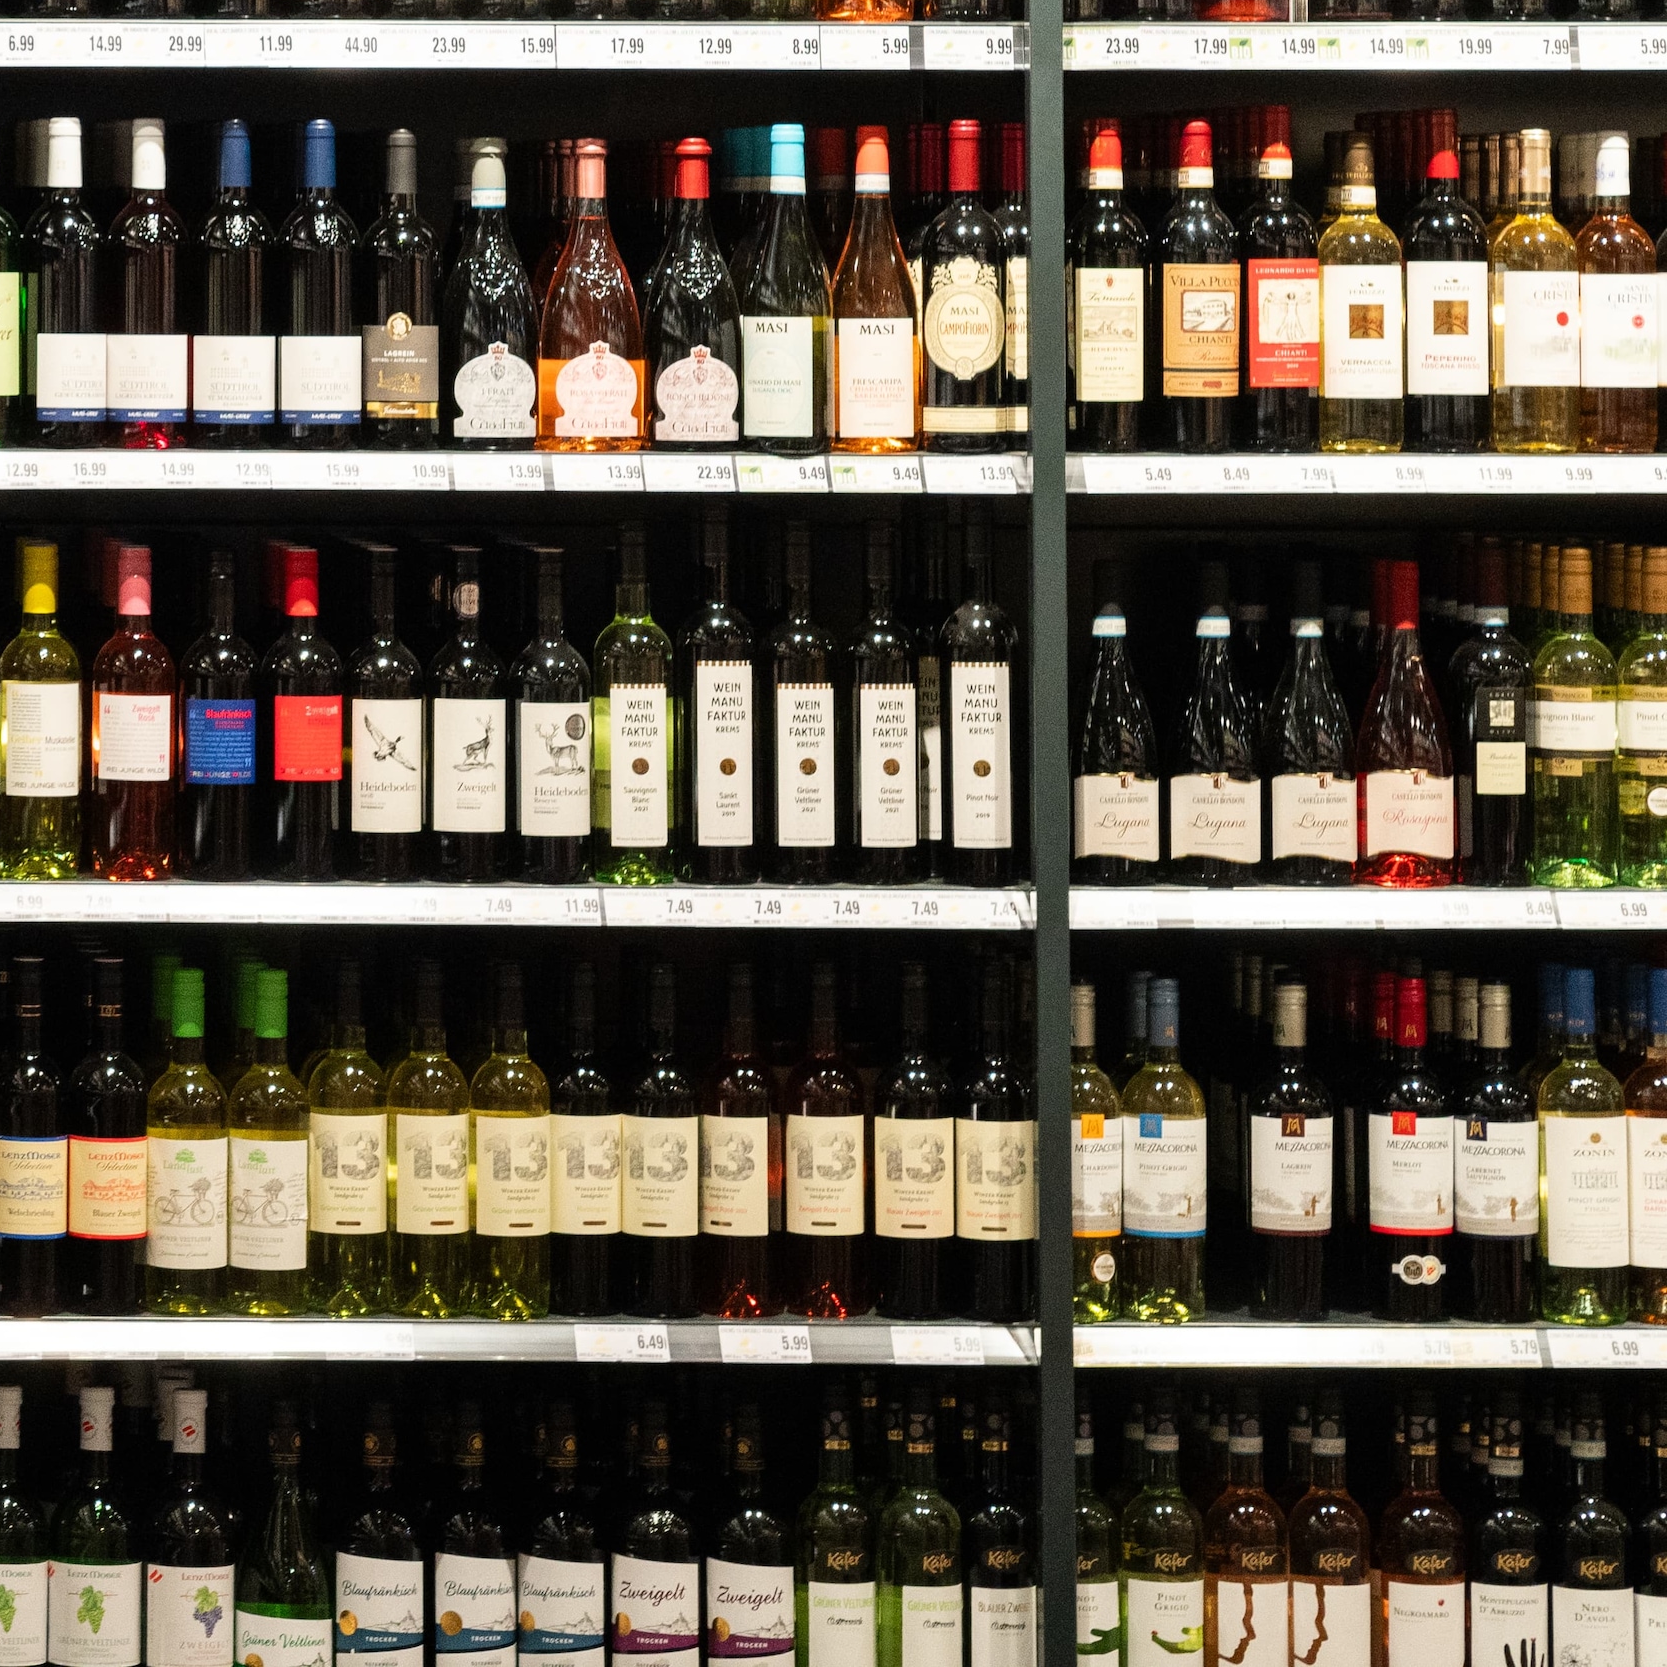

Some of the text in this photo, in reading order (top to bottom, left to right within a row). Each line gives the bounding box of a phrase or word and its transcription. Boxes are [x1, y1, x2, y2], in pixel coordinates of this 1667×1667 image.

[9, 36, 34, 51] 6.99
[89, 36, 122, 51] 14.99
[169, 36, 202, 51] 29.99
[259, 36, 292, 52] 11.99
[345, 37, 377, 53] 44.90
[433, 38, 465, 53] 23.99
[521, 38, 554, 53] 15.99
[611, 39, 644, 53] 17.99
[699, 39, 732, 54] 12.99
[793, 39, 818, 54] 8.99
[883, 39, 908, 54] 5.99
[986, 39, 1012, 54] 9.99
[1282, 39, 1315, 54] 14.99
[1459, 40, 1492, 54] 19.99
[1543, 40, 1569, 54] 7.99
[1171, 276, 1206, 287] VILLA
[950, 306, 979, 316] MASI
[755, 322, 788, 333] MASI
[860, 324, 895, 335] MASI
[1189, 336, 1232, 344] CHIANTI
[1425, 354, 1476, 362] PEPERINO
[74, 463, 106, 476] 16.99
[413, 465, 445, 478] 10.99
[509, 465, 542, 478] 13.99
[698, 466, 730, 480] 22.99
[799, 467, 825, 481] 9.49
[1145, 468, 1171, 481] 5.49
[1223, 468, 1249, 480] 8.49
[1301, 468, 1327, 480] 7.99
[1566, 468, 1593, 480] 9.99
[714, 683, 741, 693] WEIN
[132, 704, 160, 713] Zweigelt
[711, 697, 743, 706] MANU
[794, 701, 820, 710] WEIN
[707, 711, 746, 721] FAKTUR
[793, 714, 823, 723] MANU
[789, 728, 825, 737] FAKTUR
[360, 783, 417, 792] Heideboden
[457, 783, 496, 793] Zweigelt
[719, 792, 738, 800] Sankt
[795, 796, 821, 804] Veltliner
[1095, 812, 1149, 838] Lugana
[1189, 812, 1246, 838] Lugana
[486, 899, 512, 912] 7.49
[667, 900, 693, 914] 7.49
[755, 901, 781, 914] 7.49
[1135, 1143, 1197, 1152] MEZZACORONA
[1462, 1145, 1525, 1156] MEZZACORONA
[314, 1132, 379, 1179] 13
[793, 1133, 857, 1181] 13
[879, 1133, 945, 1182] 13
[1466, 1166, 1501, 1174] CABERNET
[1467, 1173, 1506, 1181] SAUVIGNON
[637, 1334, 664, 1350] 6.49
[782, 1336, 808, 1350] 5.99
[1511, 1340, 1538, 1354] 5.79
[827, 1553, 864, 1570] Käfer
[923, 1555, 953, 1574] Käfer
[988, 1550, 1025, 1569] Käfer
[1155, 1553, 1191, 1571] Käfer
[1241, 1552, 1277, 1570] Käfer
[1319, 1553, 1357, 1571] Käfer
[342, 1580, 416, 1597] Blaufränkisch
[523, 1580, 595, 1598] Blaufränkisch
[620, 1580, 686, 1607] Zweigelt
[717, 1586, 783, 1611] Zweigelt
[1157, 1593, 1186, 1602] PINOT
[1479, 1595, 1539, 1604] MONTEPULCIANO
[1155, 1603, 1189, 1612] GRIGIO
[1394, 1608, 1449, 1618] NEGROAMARO
[1582, 1603, 1609, 1612] NERO
[243, 1631, 325, 1648] Grüner Veltliner
